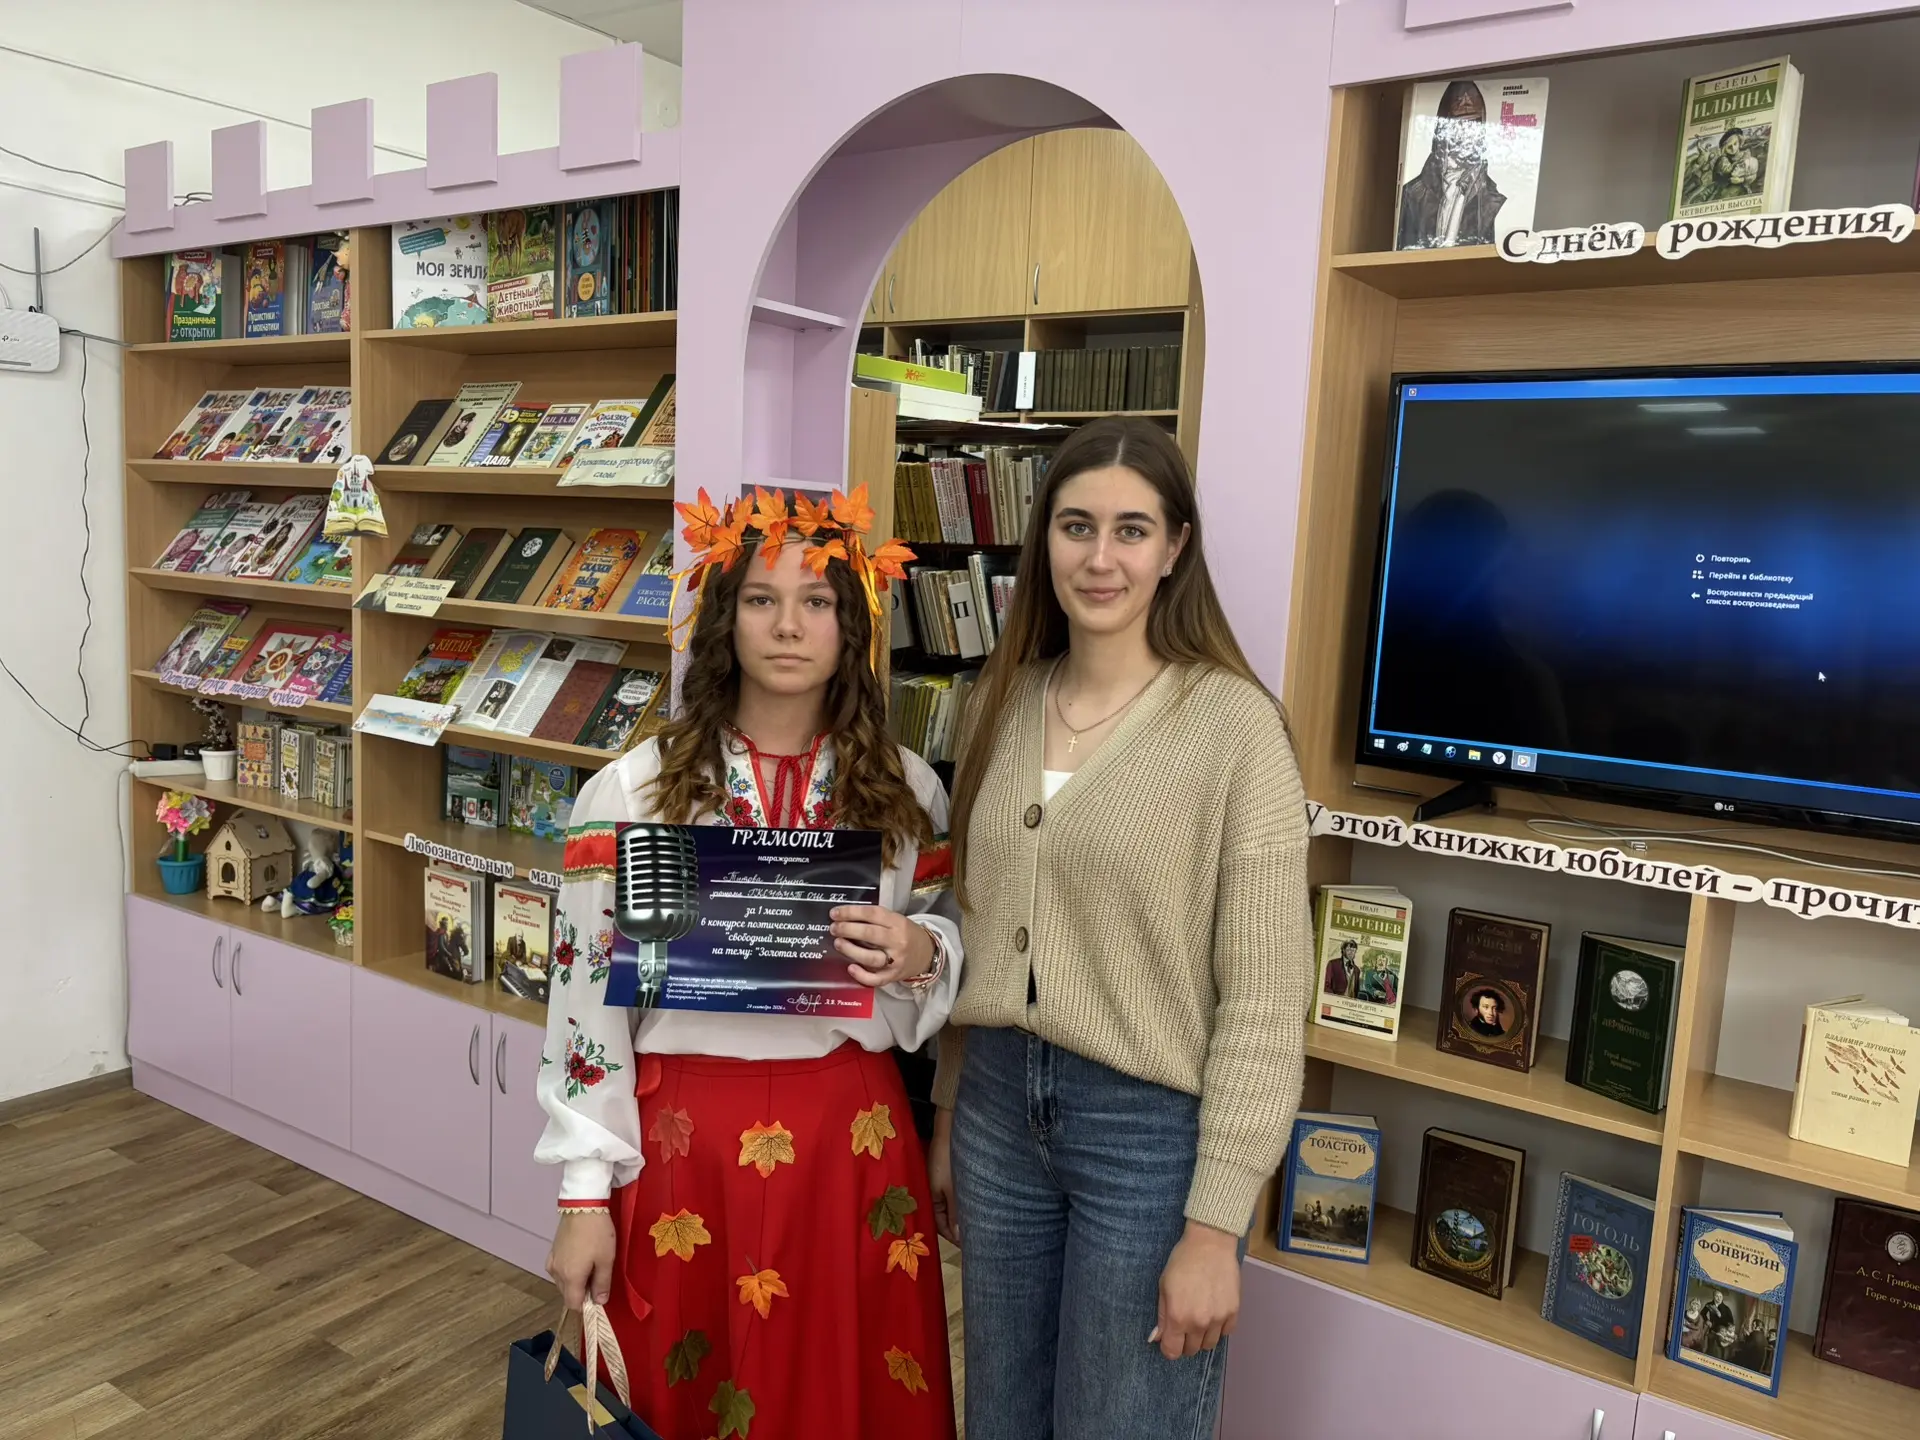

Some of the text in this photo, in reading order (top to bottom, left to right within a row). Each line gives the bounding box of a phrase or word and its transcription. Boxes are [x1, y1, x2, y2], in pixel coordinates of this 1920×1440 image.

[1714, 75, 1758, 91] ЕЛЕНА
[1693, 88, 1773, 119] ИЛЬИНА
[1728, 197, 1763, 211] ВЫСОТА
[1502, 211, 1906, 260] С днём рождения,
[416, 261, 445, 277] МОЯ
[496, 299, 541, 317] ЖИВОТНЫХ
[173, 314, 216, 326] Праздничные
[481, 454, 511, 466] ДАЛЬ
[1711, 554, 1751, 564] Повторить
[1709, 571, 1741, 581] Перейти
[1749, 572, 1794, 584] библиотеку
[1707, 588, 1814, 601] Воспроизвести предыдущий
[952, 601, 970, 620] П
[1706, 598, 1800, 610] список воспроизведения
[435, 638, 472, 653] КИТАЙ
[161, 670, 203, 688] Детские
[229, 680, 269, 699] творят
[271, 689, 305, 706] чудеса
[731, 829, 835, 848] ГРАМОТА
[404, 836, 514, 878] Любознательным
[757, 854, 810, 865] награждается
[1331, 815, 1403, 843] этой
[1411, 827, 1555, 869] книжки
[1565, 850, 1721, 894] юбилей
[744, 906, 793, 918] за 1 место
[701, 917, 706, 926] в
[707, 919, 746, 932] конкурсе
[747, 921, 805, 931] поэтического
[1334, 912, 1402, 935] ТУРГЕНЕВ
[725, 932, 824, 948] "свободный микрофон"
[712, 947, 828, 960] на тему: "Золотая осень"
[1602, 1018, 1651, 1040] ЛЕРМОНТОВ
[1824, 1032, 1907, 1057] ВЛАДИМИР ЛУГОВСКОЙ
[1309, 1137, 1367, 1155] ТОЛСТОЙ
[1572, 1212, 1641, 1252] ГОГОЛЬ
[1698, 1239, 1780, 1273] ФОНВИЗИН
[1856, 1266, 1868, 1278] А.
[1871, 1270, 1883, 1281] С.
[1865, 1286, 1888, 1301] Горе
[1889, 1296, 1901, 1305] от
